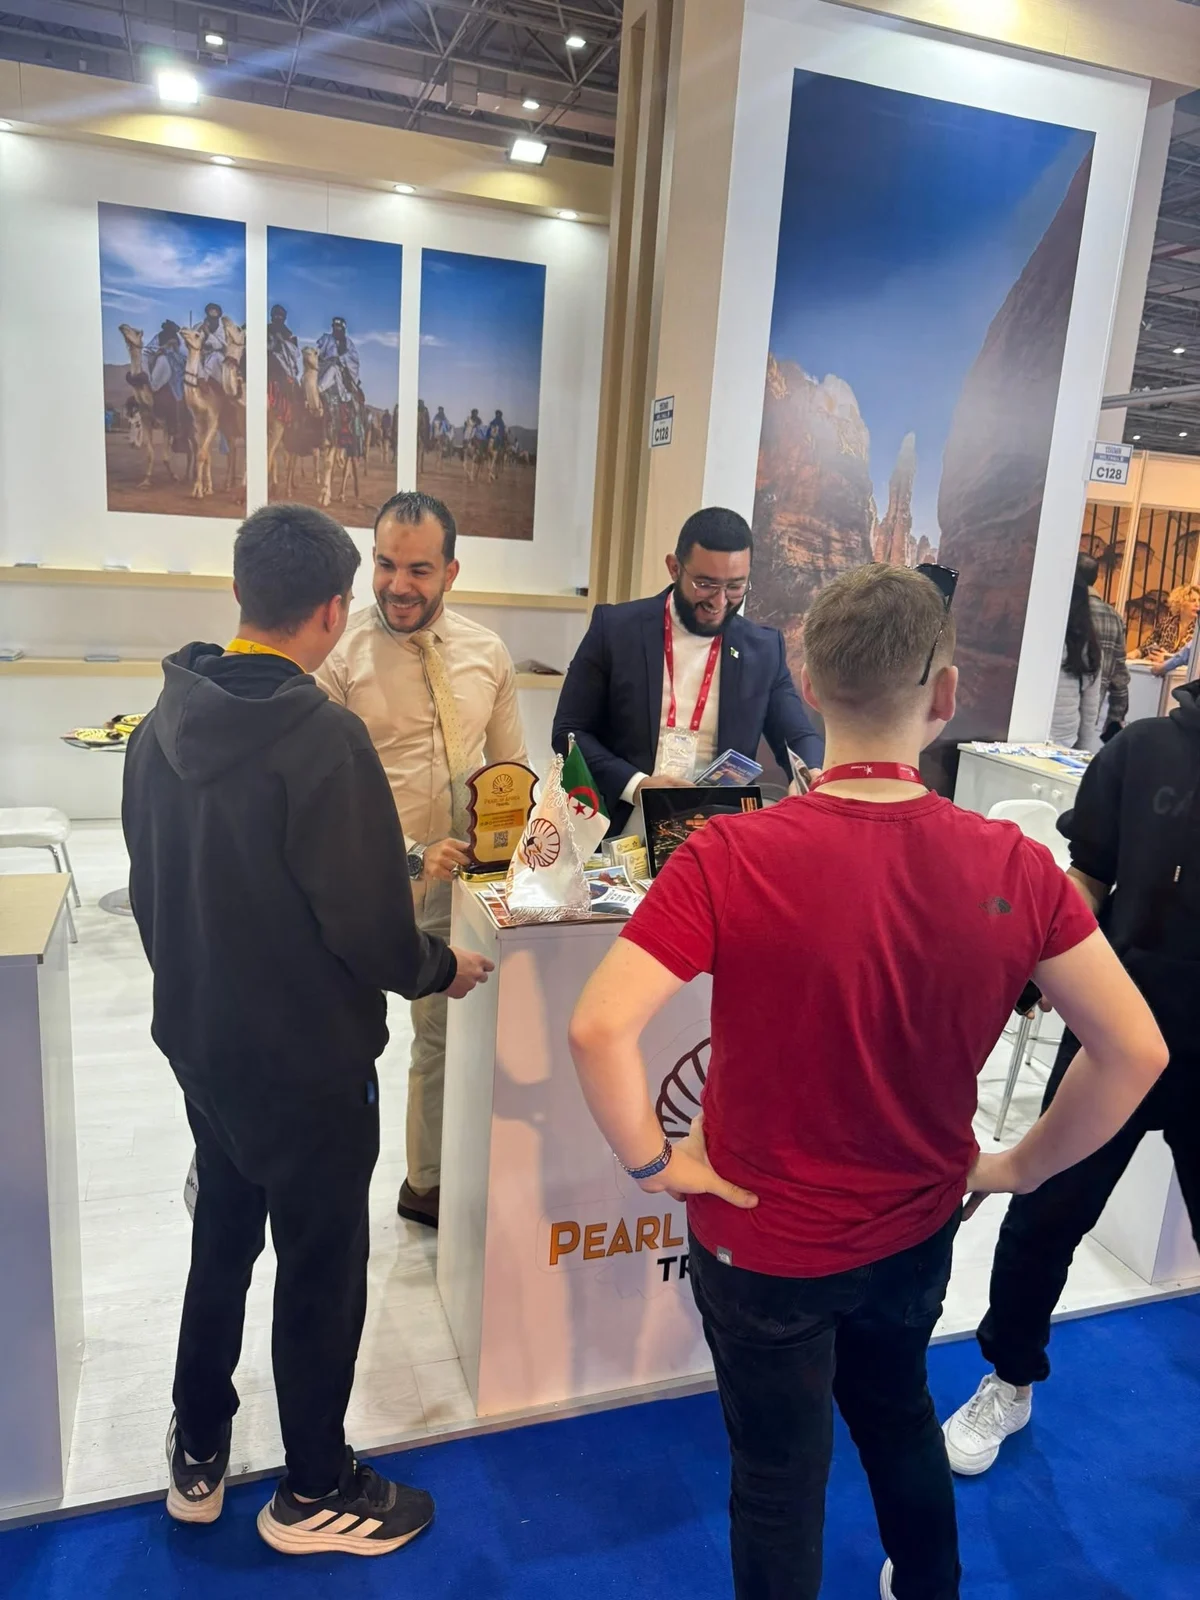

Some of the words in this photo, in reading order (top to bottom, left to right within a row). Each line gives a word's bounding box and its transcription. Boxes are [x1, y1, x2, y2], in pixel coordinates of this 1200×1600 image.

[655, 427, 669, 442] C128
[1096, 466, 1123, 480] C128
[549, 1212, 684, 1266] PEARL
